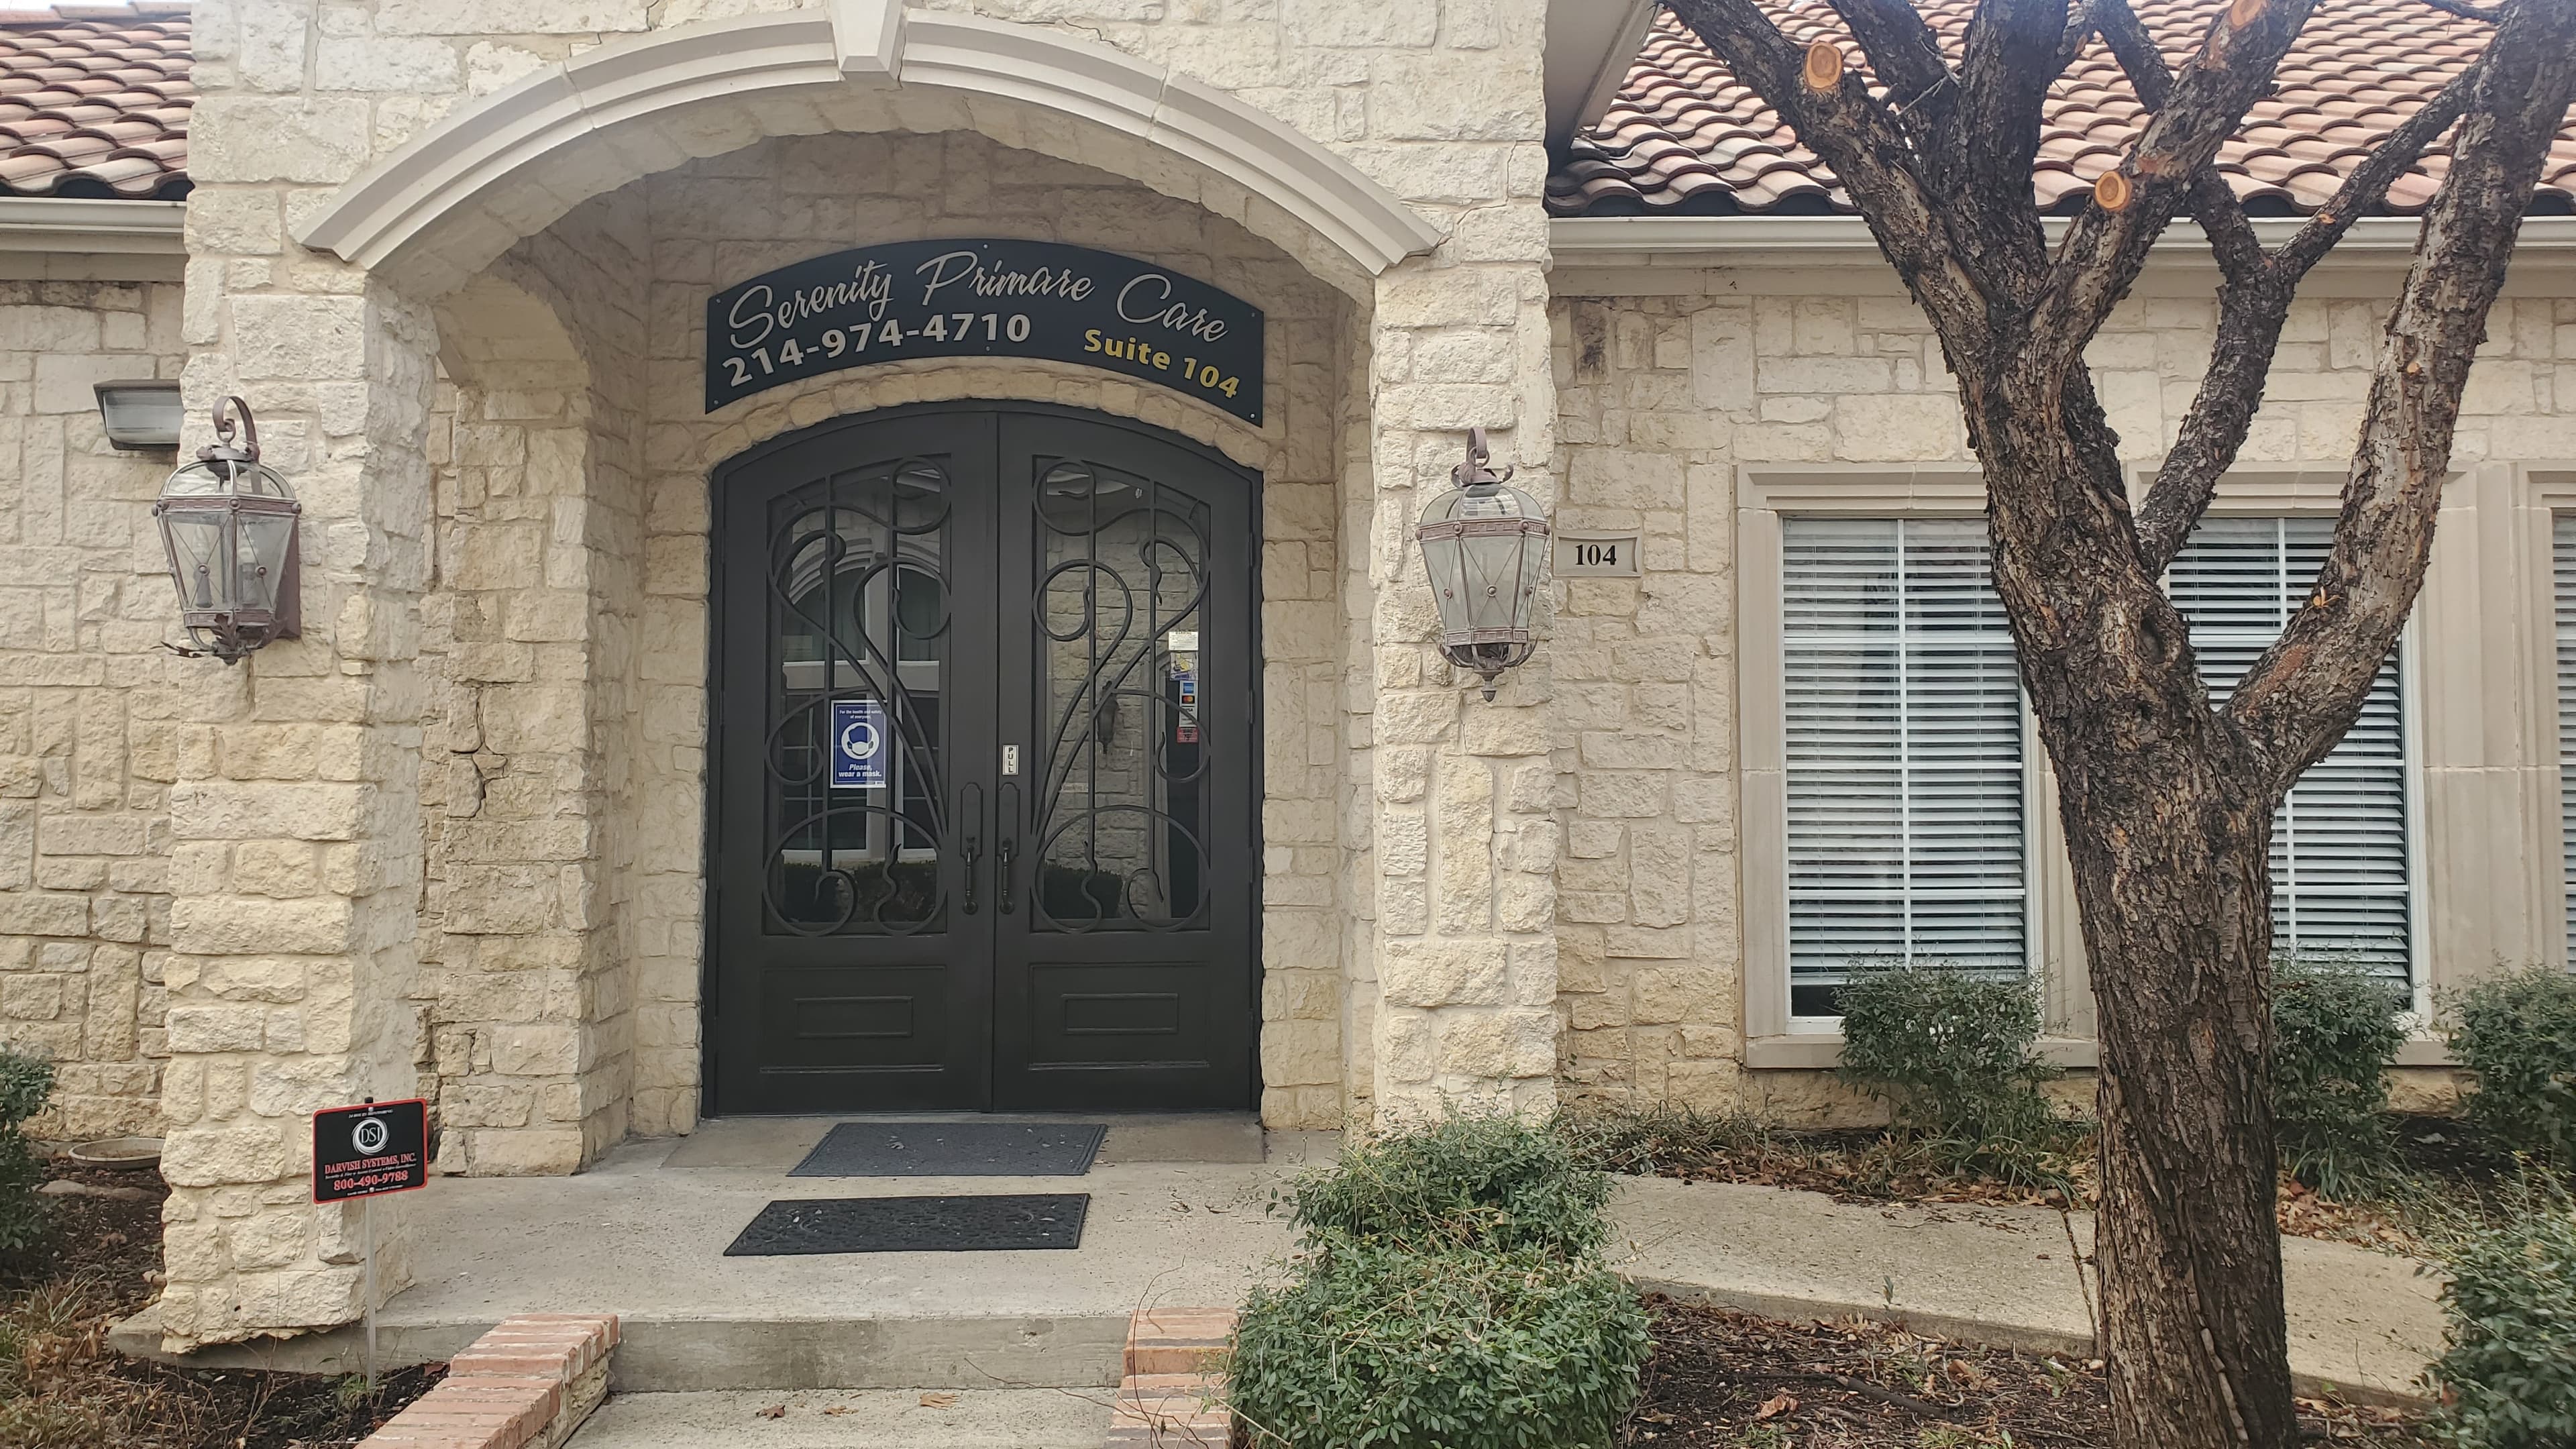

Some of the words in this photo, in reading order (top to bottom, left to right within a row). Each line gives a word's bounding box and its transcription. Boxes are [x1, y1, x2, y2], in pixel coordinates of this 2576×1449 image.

[729, 260, 895, 349] Serenity
[915, 251, 1095, 306] Primare
[1116, 273, 1228, 342] Care
[722, 313, 1030, 387] 214-974-4710
[1084, 329, 1171, 370] Suite
[1183, 357, 1240, 398] 104
[1575, 544, 1617, 566] 104
[849, 763, 873, 771] Please,
[361, 1127, 380, 1143] DSI
[324, 1160, 361, 1175] DARVISH
[362, 1155, 400, 1169] SYSTEMS,
[400, 1152, 417, 1163] INC.
[333, 1170, 409, 1191] 800-490-9788
